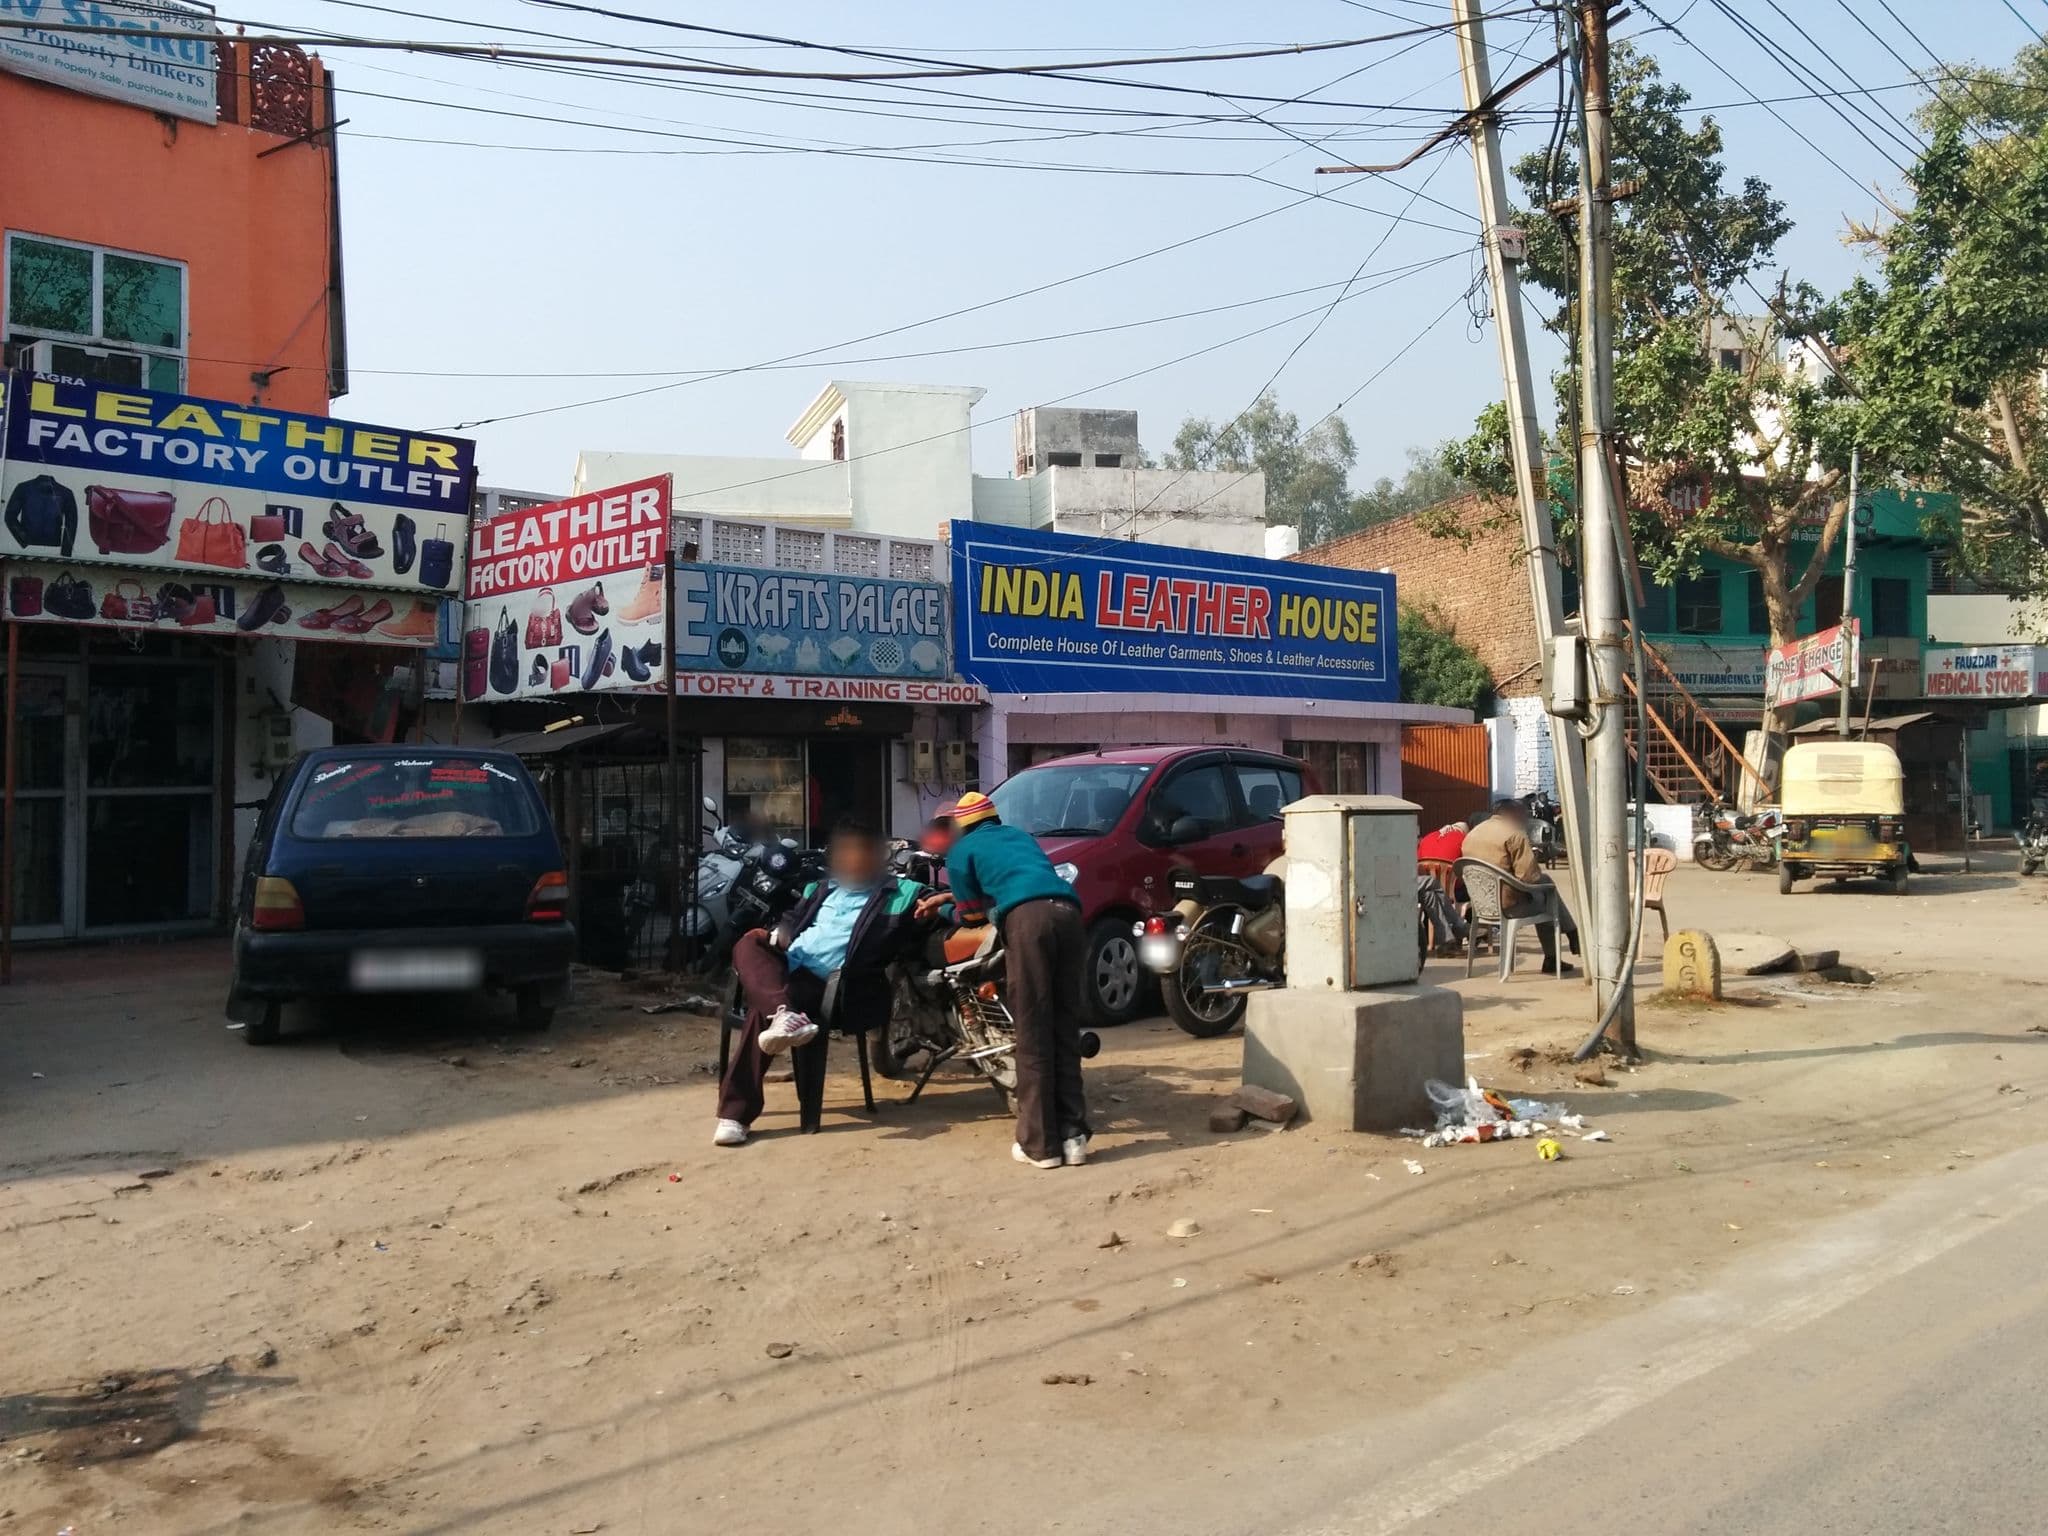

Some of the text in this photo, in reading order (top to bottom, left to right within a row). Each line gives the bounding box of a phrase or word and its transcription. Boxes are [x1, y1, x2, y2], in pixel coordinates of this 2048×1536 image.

[22, 27, 117, 68] Property
[128, 52, 205, 88] Linkers
[54, 58, 97, 79] Property
[127, 80, 175, 99] purchase
[176, 92, 185, 102] &
[186, 95, 208, 108] Rent
[34, 370, 87, 387] AGRA
[31, 381, 459, 471] LEATHER
[27, 418, 460, 499] FACTORY OUTLET
[472, 487, 662, 560] LEATHER
[470, 527, 663, 597] FACTORY OUTLET
[715, 571, 830, 631] KRAFTS
[838, 582, 941, 636] PALACE
[980, 565, 1378, 643] INDIA LEATHER HOUSE
[987, 632, 1376, 672] Complete House Of Leather Garments, Shoes & Leather Accessories
[1699, 673, 1751, 685] FINANCING
[1954, 654, 1998, 669] FAUZDAR
[761, 678, 775, 696] &
[785, 678, 901, 701] TRAINING
[906, 683, 983, 703] SCHOOL
[1927, 670, 2029, 695] MEDICAL STORE
